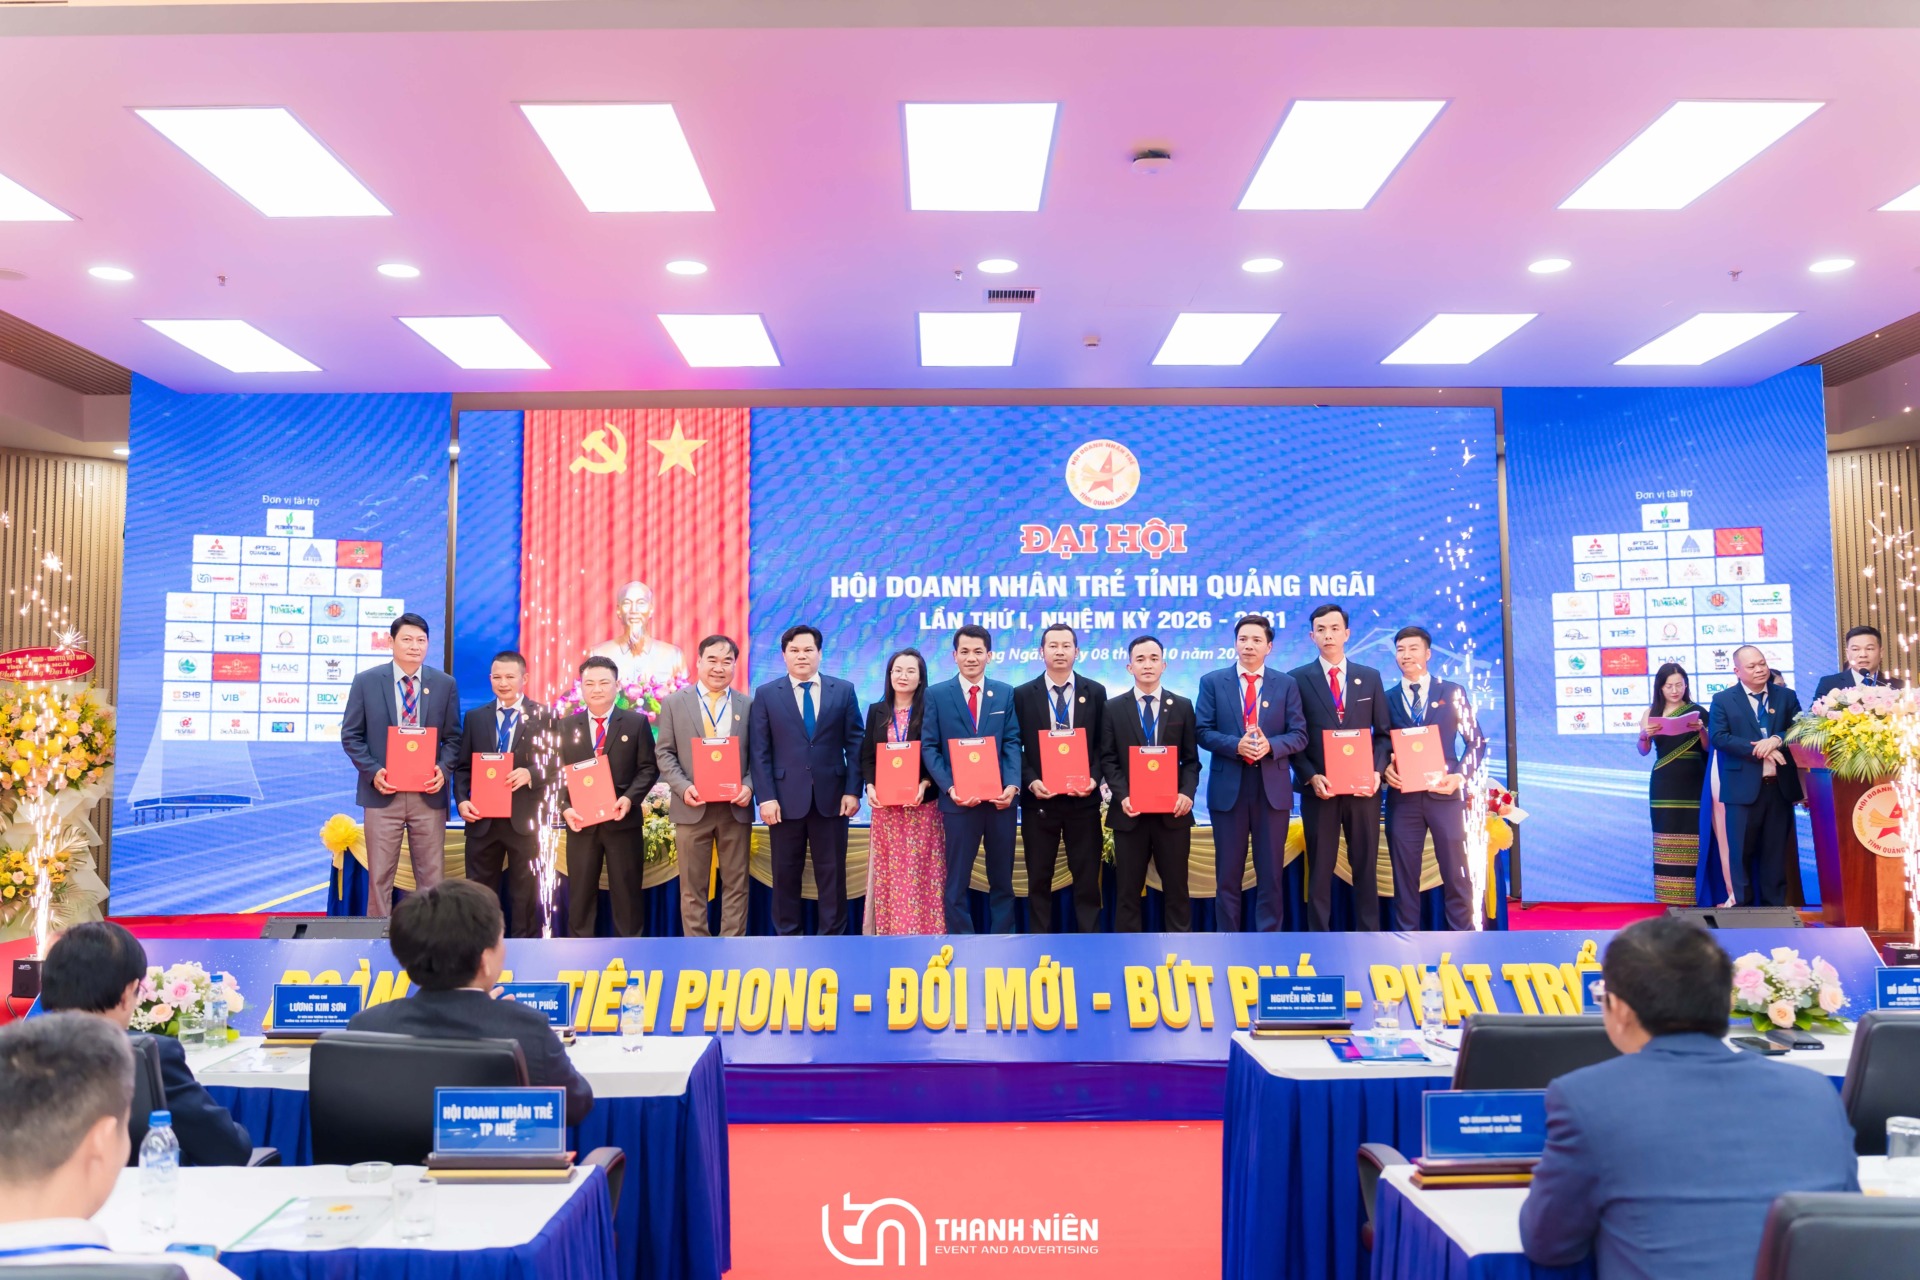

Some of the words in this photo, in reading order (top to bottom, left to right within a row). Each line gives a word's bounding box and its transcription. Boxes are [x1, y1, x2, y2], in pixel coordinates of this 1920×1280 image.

[262, 494, 281, 504] Đơn
[284, 496, 292, 506] vị
[294, 496, 305, 505] tài
[307, 497, 320, 507] trợ
[1635, 491, 1654, 500] Đơn
[1656, 491, 1665, 500] vị
[1667, 489, 1678, 498] tài
[1680, 489, 1693, 498] trợ
[1020, 524, 1098, 560] ĐẠI
[1105, 517, 1187, 560] HỘI
[830, 572, 877, 602] HỘI
[886, 575, 980, 598] DOANH
[989, 572, 1068, 598] NHÂN
[1076, 568, 1126, 598] TRẺ
[1134, 568, 1198, 597] TỈNH
[1206, 568, 1300, 599] QUẢNG
[1309, 571, 1375, 597] NGÃI
[919, 606, 963, 630] LẦN
[969, 608, 1015, 630] THỨ
[1020, 611, 1034, 631] I,
[1041, 608, 1115, 633] NHIỆM
[1122, 608, 1151, 629] KỲ
[1157, 611, 1212, 629] 2026
[1234, 611, 1286, 629] 231
[1008, 648, 1044, 663] Ngã
[1091, 648, 1110, 660] 08
[1181, 648, 1213, 660] năm
[317, 693, 338, 701] BIDV
[1574, 686, 1592, 694] SHB
[1612, 687, 1629, 695] VIB
[1867, 786, 1893, 800] DOANH
[557, 957, 664, 1032] TIÊN
[670, 967, 838, 1032] PHONG
[853, 994, 872, 1012] -
[886, 944, 968, 1031] ĐỔI
[984, 954, 1078, 1031] MỚI
[1092, 992, 1111, 1011] -
[1124, 953, 1214, 1029] BỨT
[314, 1002, 329, 1012] KIM
[331, 1001, 346, 1012] SƠN
[539, 999, 558, 1010] PHÚC
[442, 1103, 461, 1122] HỘI
[463, 1106, 499, 1120] DOANH
[501, 1103, 531, 1120] NHÂN
[533, 1102, 553, 1120] TRẺ
[479, 1122, 493, 1136] TP
[495, 1119, 517, 1136] HUẾ
